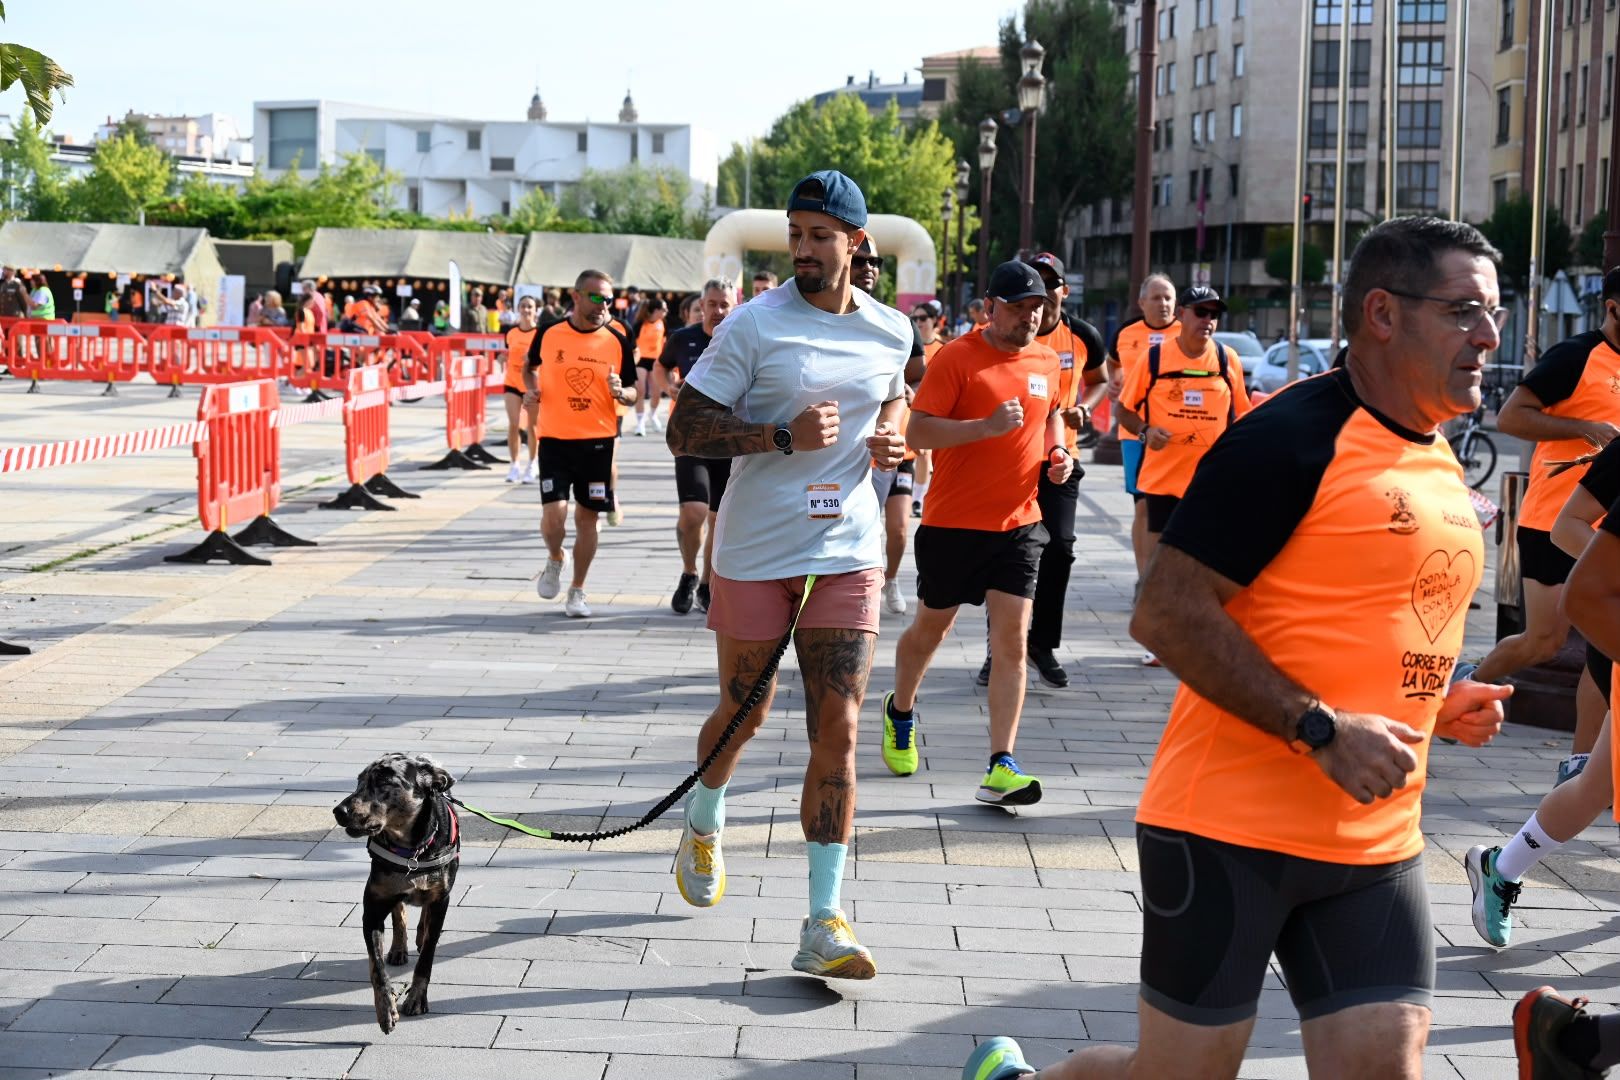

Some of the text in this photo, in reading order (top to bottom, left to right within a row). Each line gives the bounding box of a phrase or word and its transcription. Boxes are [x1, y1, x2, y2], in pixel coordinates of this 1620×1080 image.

[823, 498, 840, 508] 530
[1422, 574, 1461, 601] MEDULA
[1401, 650, 1455, 672] CORRE POR
[1401, 669, 1446, 691] LA VIDA
